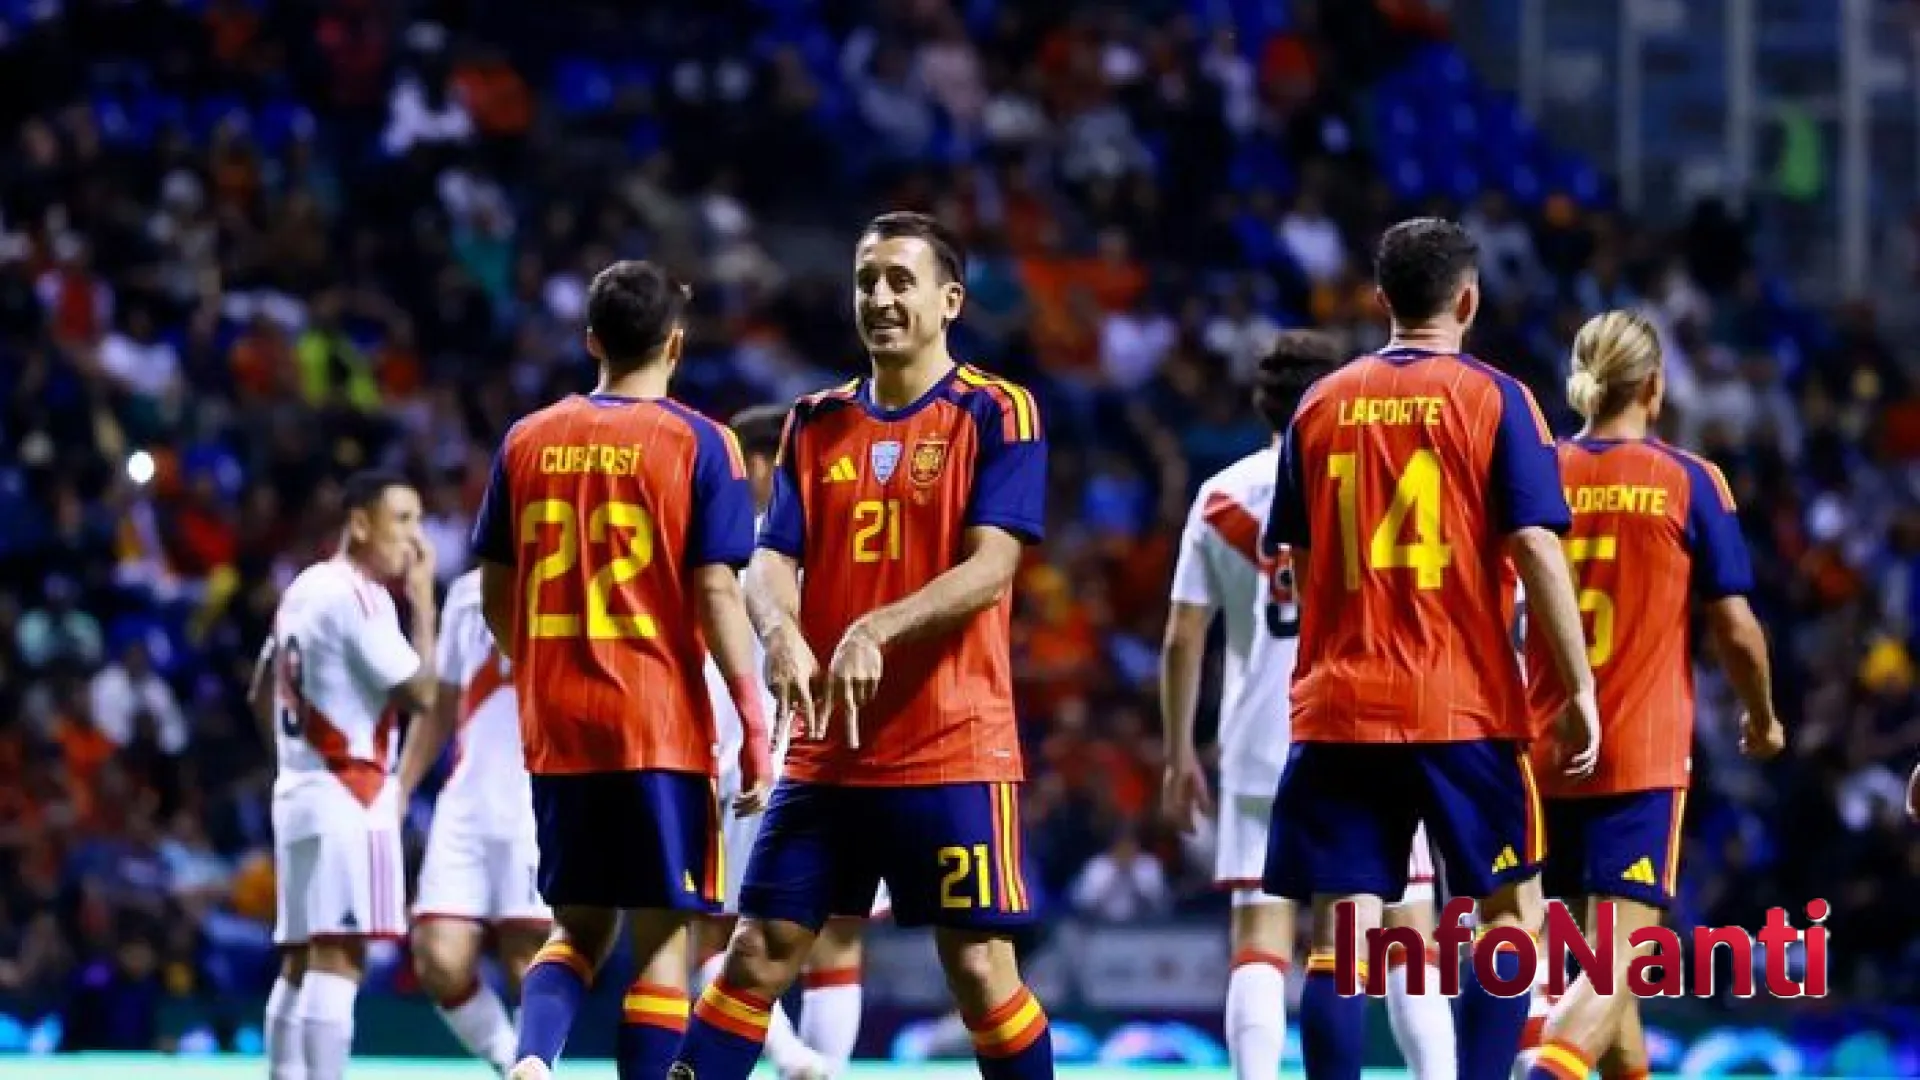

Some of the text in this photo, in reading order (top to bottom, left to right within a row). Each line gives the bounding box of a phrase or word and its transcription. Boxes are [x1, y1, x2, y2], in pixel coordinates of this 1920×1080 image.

[521, 499, 656, 638] 22
[854, 499, 901, 562] 21
[1328, 449, 1450, 589] 14
[938, 843, 991, 908] 21
